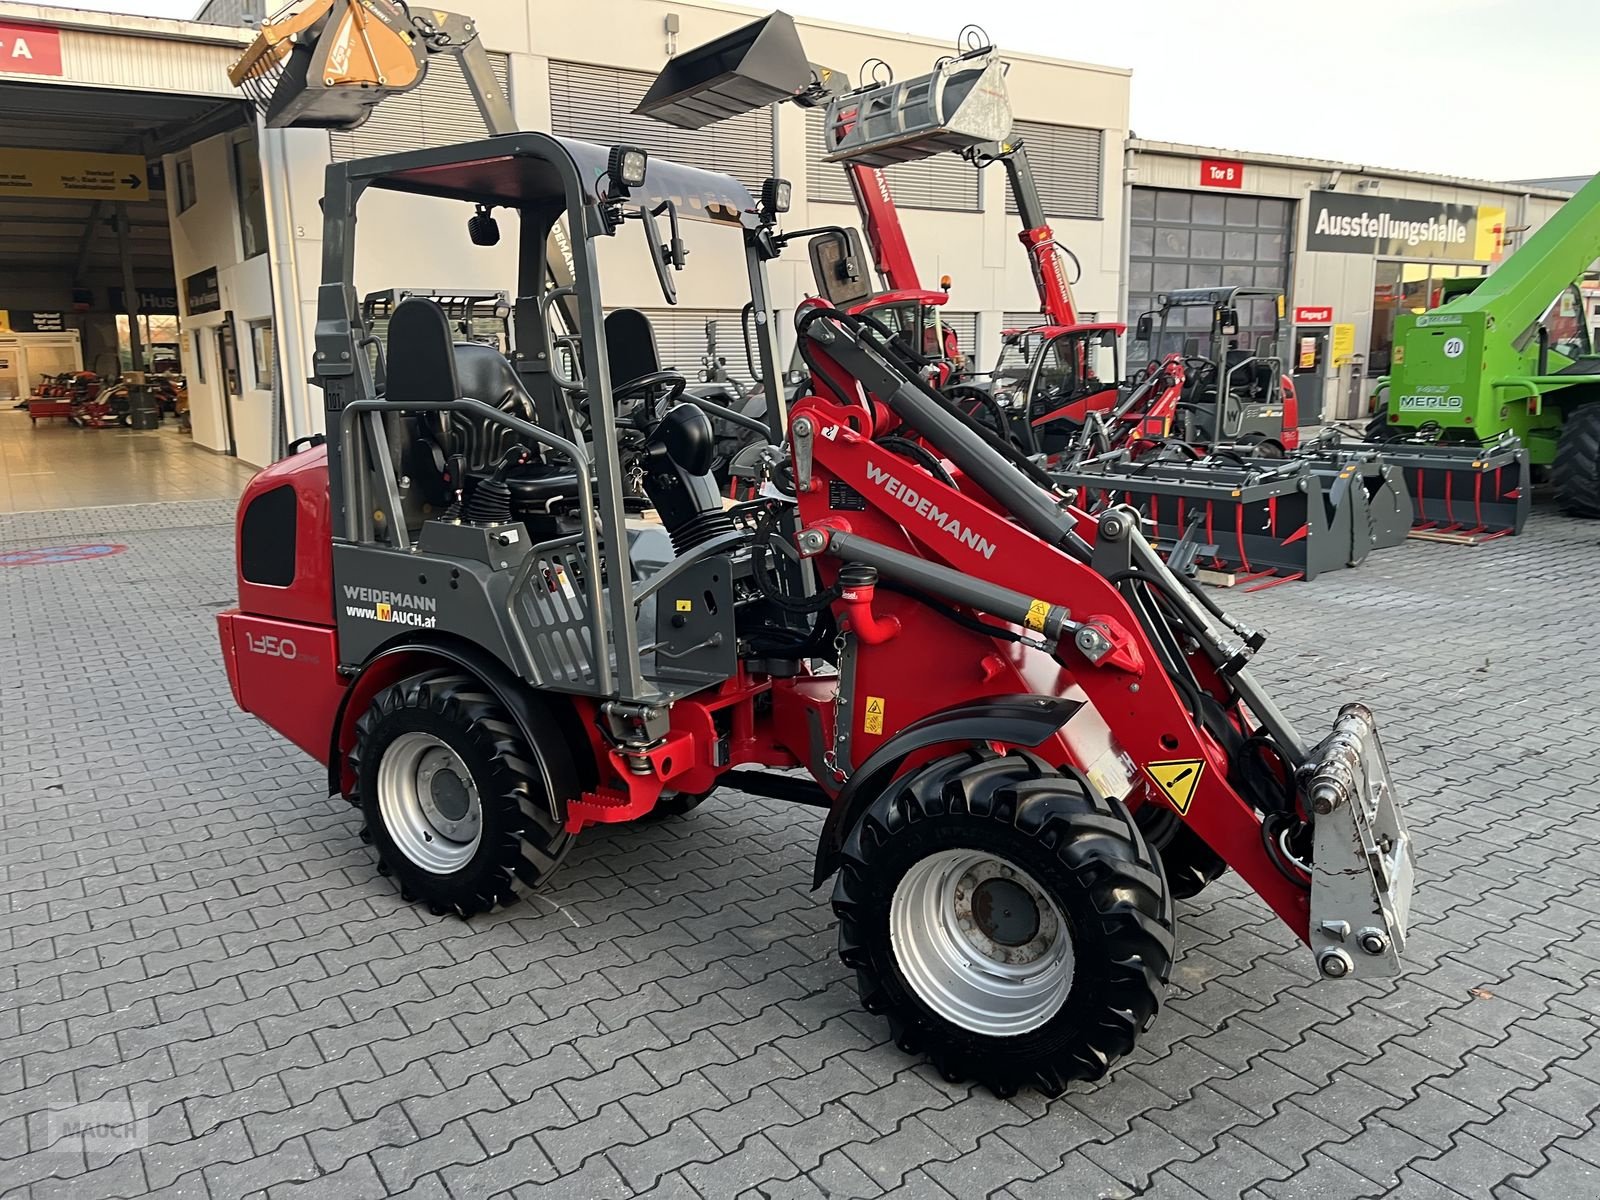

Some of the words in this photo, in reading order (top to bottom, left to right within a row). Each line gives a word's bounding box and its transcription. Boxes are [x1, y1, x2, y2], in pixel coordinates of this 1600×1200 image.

[11, 38, 33, 59] A
[1210, 167, 1225, 179] Tor
[1226, 168, 1234, 180] B
[1315, 208, 1467, 245] Ausstellungshalle
[1447, 341, 1460, 354] 20
[1400, 396, 1462, 408] MERLO
[866, 461, 997, 559] WEIDEMANN
[343, 585, 437, 612] WEIDEMANN
[346, 605, 437, 628] www.MAUCH.at
